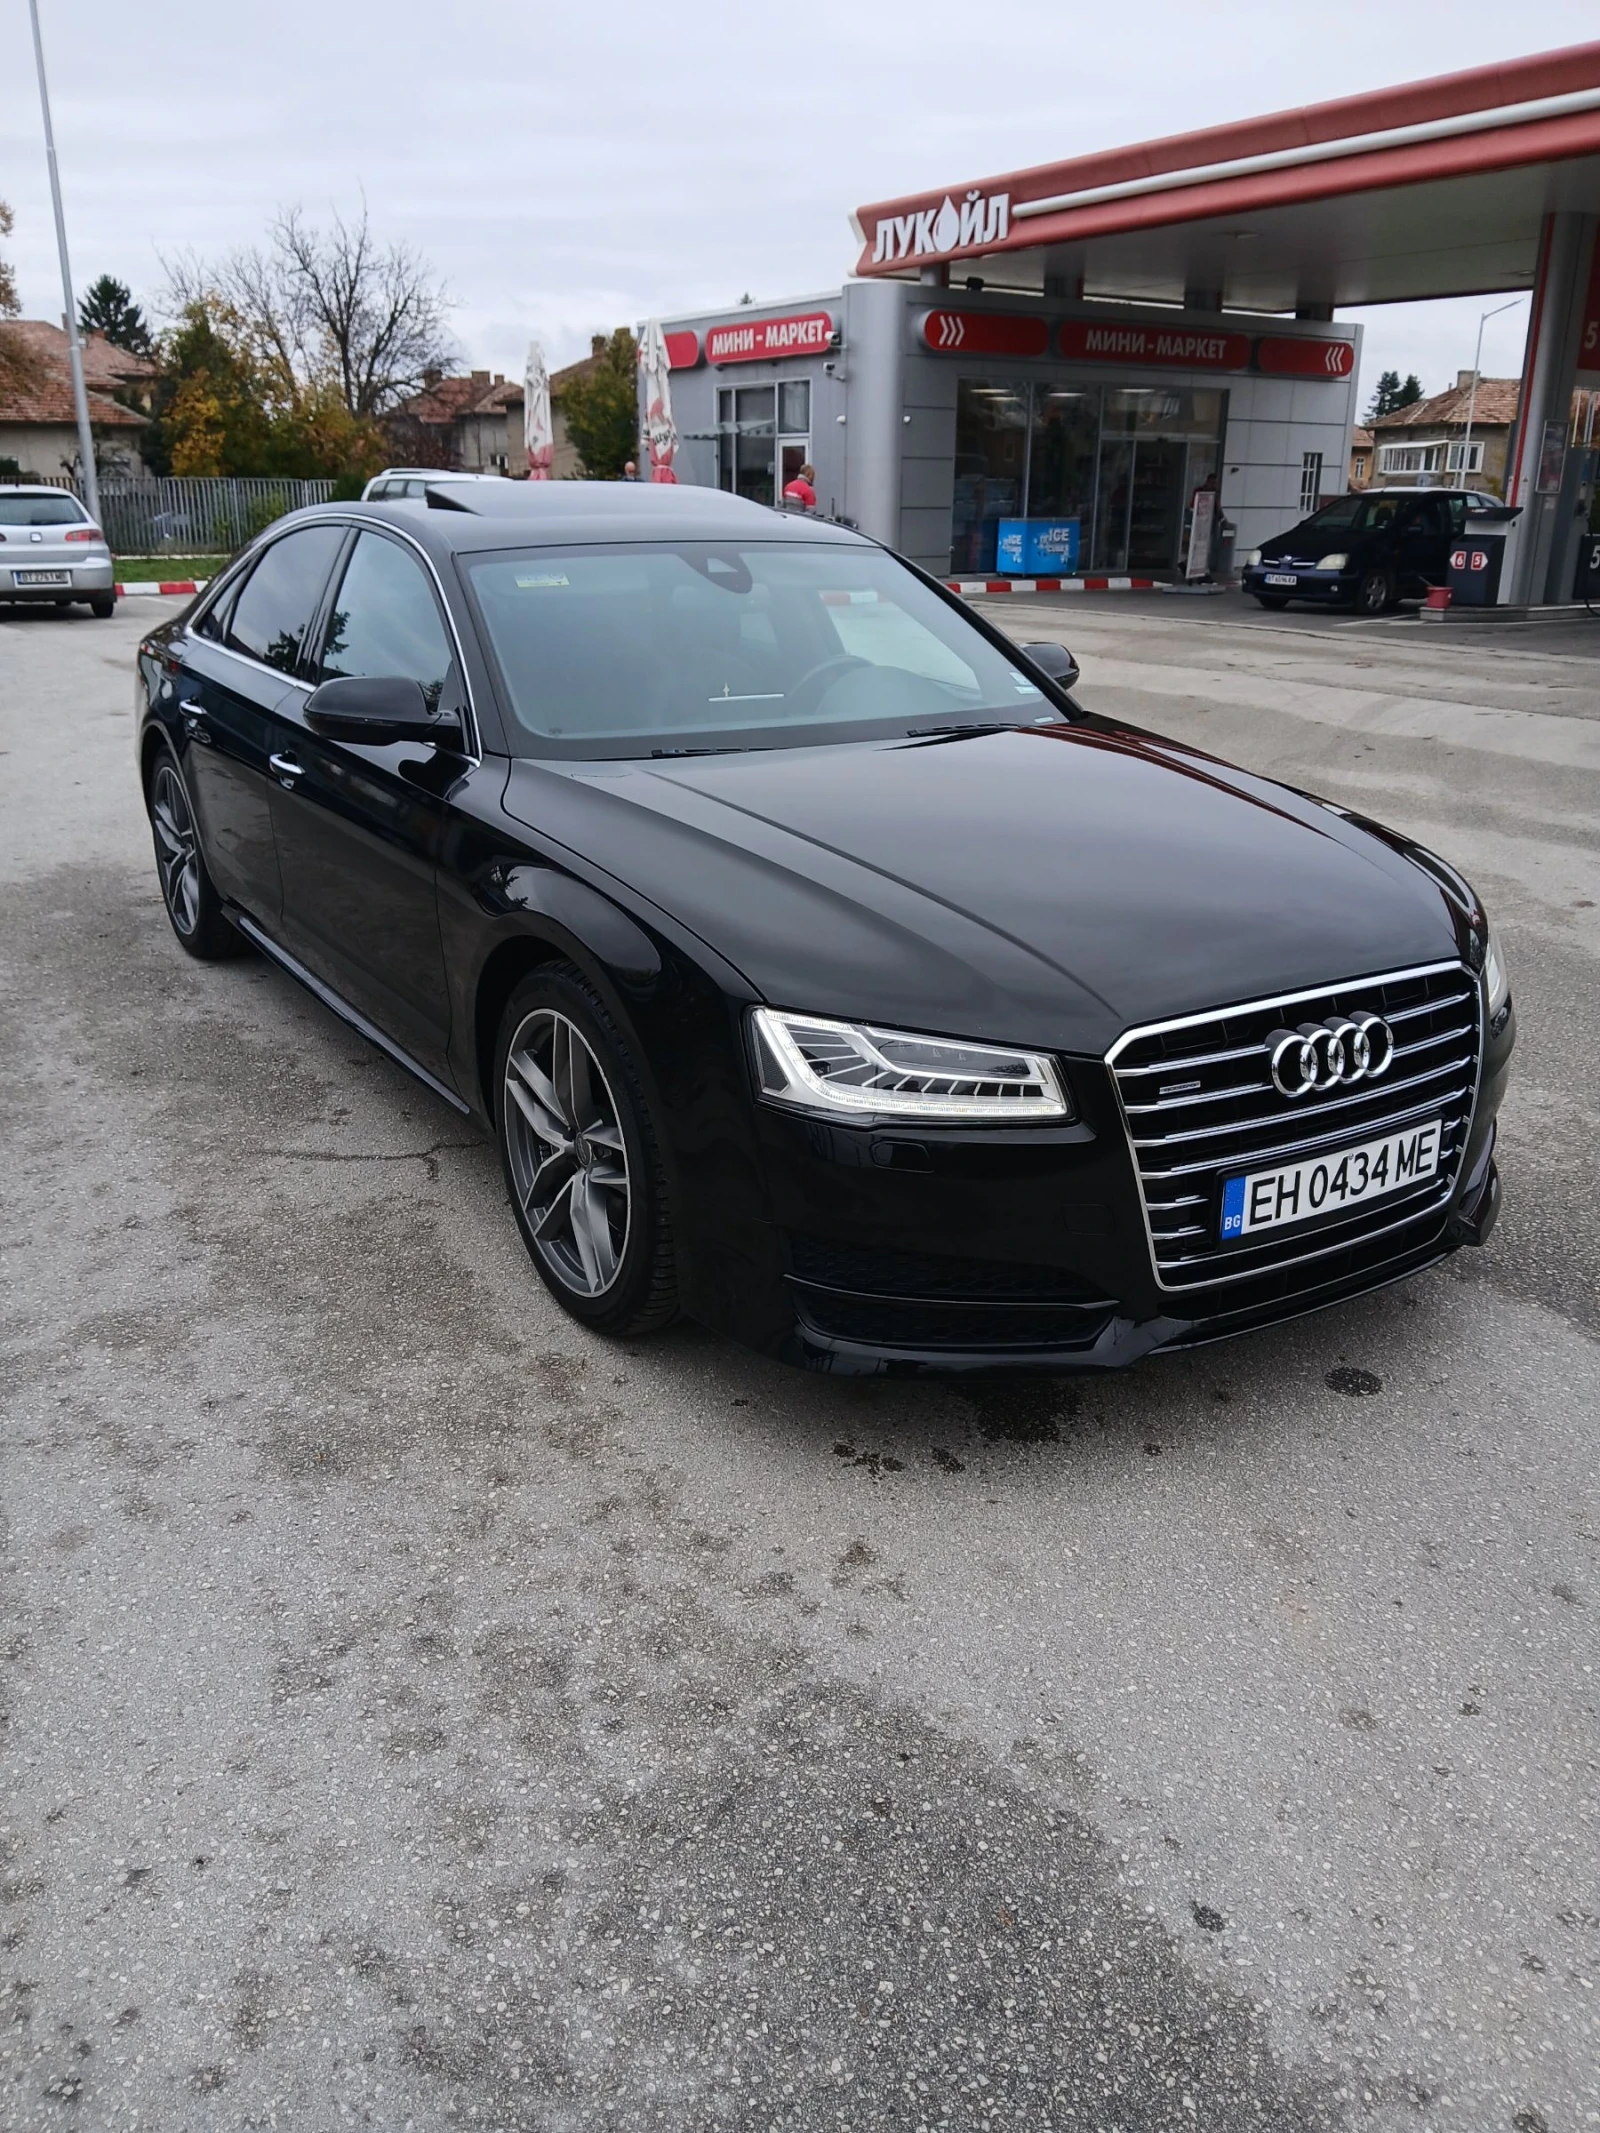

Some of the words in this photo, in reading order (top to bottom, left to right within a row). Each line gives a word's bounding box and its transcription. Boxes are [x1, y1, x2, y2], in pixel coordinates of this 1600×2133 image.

[872, 190, 1009, 264] ЛУКОЙЛ
[1048, 527, 1070, 542] ICE
[1456, 555, 1464, 566] 6
[1473, 555, 1481, 566] 5
[1224, 1214, 1241, 1231] BG
[1249, 1170, 1301, 1226] EH
[1308, 1143, 1390, 1208] 0434
[1395, 1128, 1437, 1182] ME
